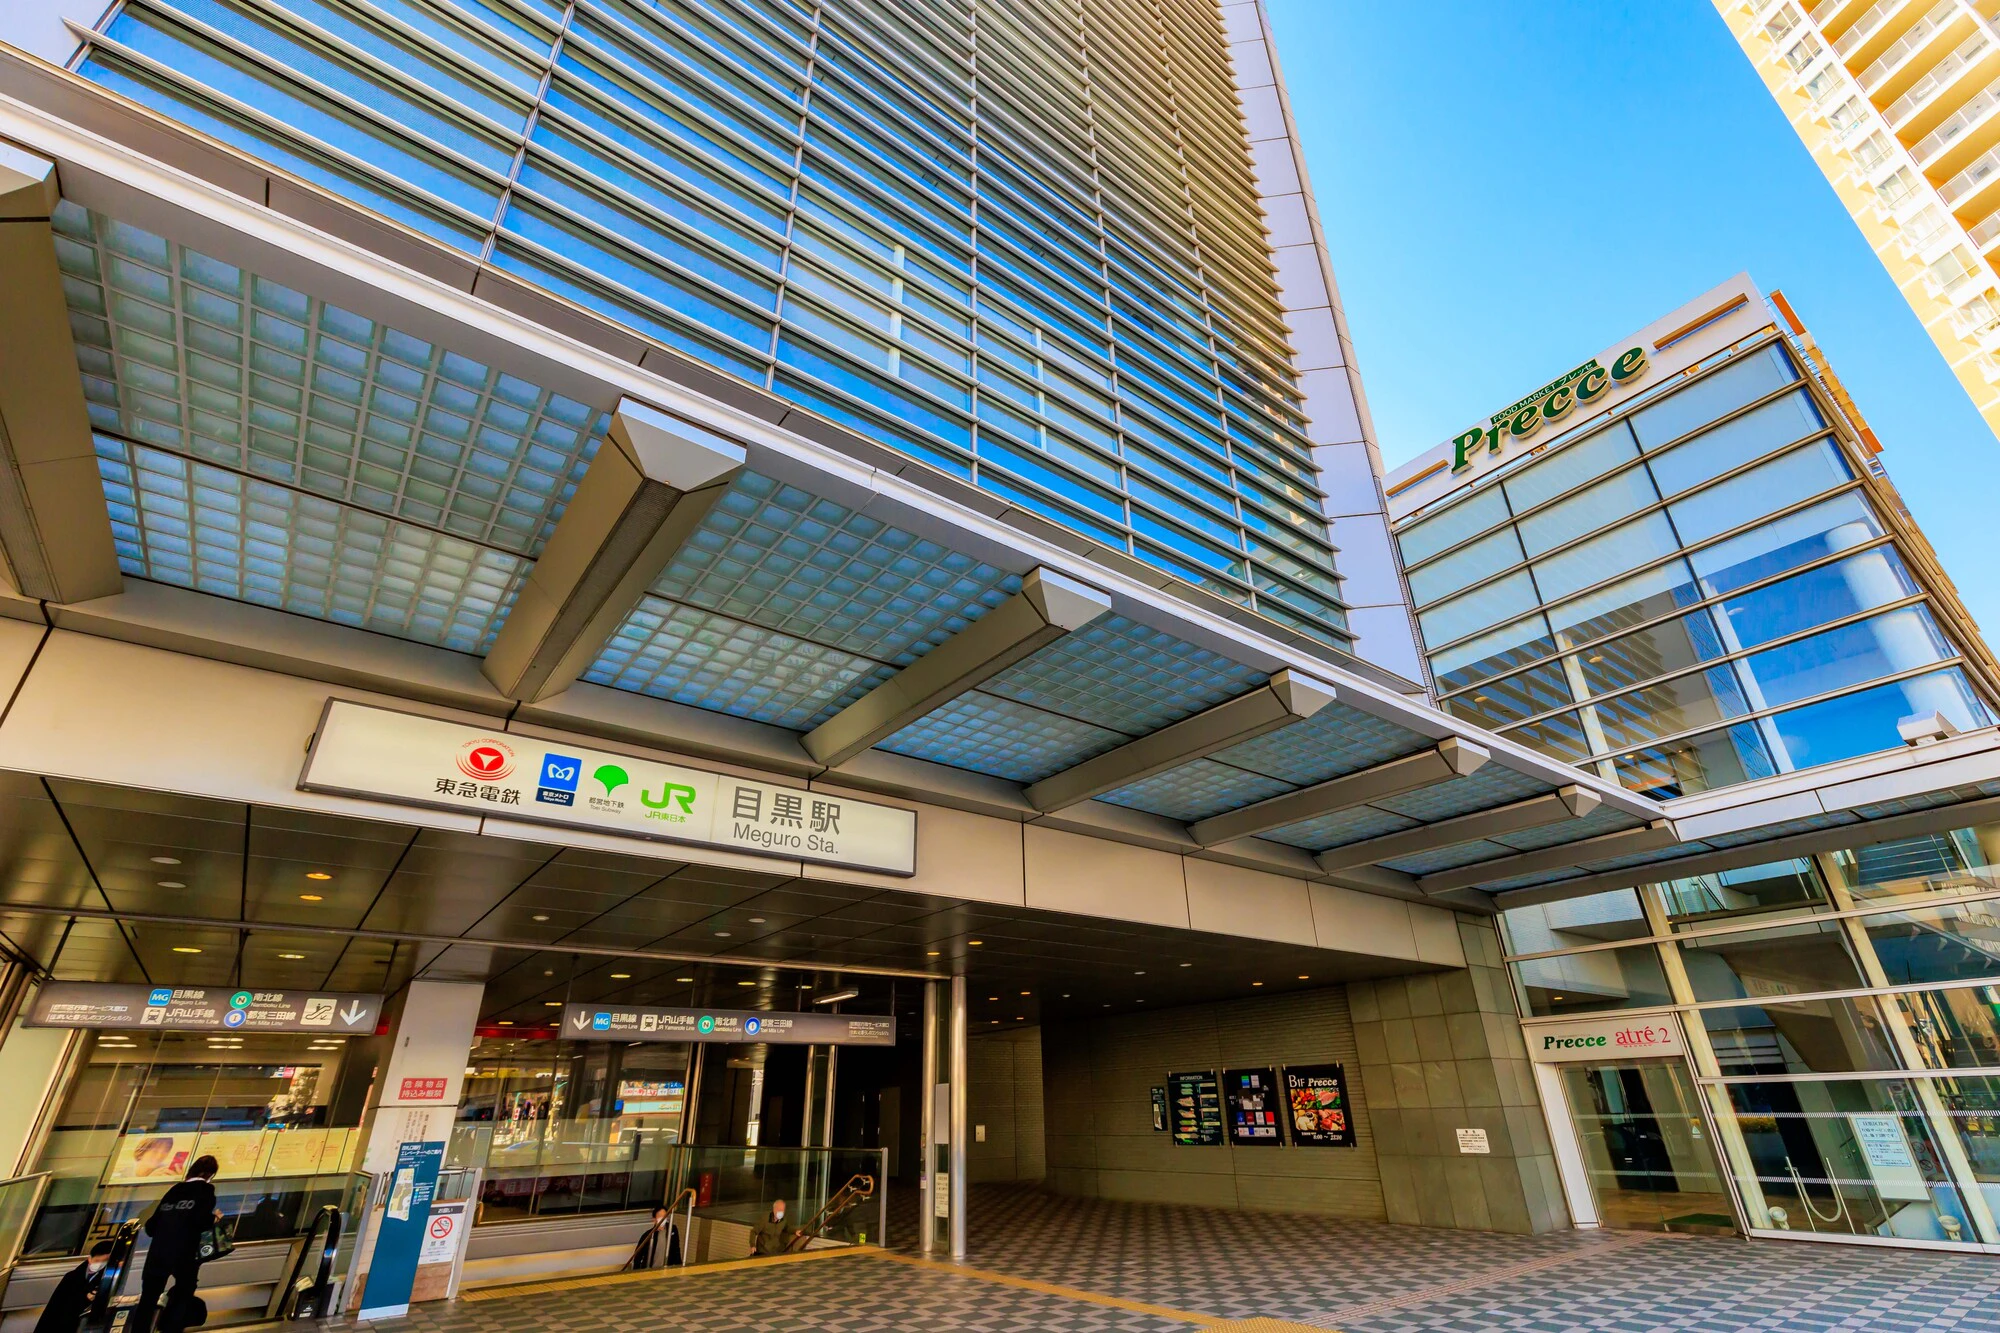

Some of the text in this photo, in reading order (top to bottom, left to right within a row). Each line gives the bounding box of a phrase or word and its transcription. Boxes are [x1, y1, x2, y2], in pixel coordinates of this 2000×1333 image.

[1493, 362, 1593, 422] FOOD MARKET プレッセ
[1451, 346, 1649, 474] Precce
[462, 738, 514, 758] TOKYU CORPORATION
[434, 777, 521, 805] 東急電鉄
[542, 790, 569, 800] 東京メトロ
[588, 796, 624, 809] 都営地下鉄
[641, 782, 697, 815] JR
[602, 806, 622, 814] Subway
[732, 785, 841, 835] 目黒駅
[645, 810, 687, 823] JR東日本
[733, 821, 839, 855] Meguro Sta.
[152, 990, 205, 1002] MG 目黒線
[253, 993, 283, 1002] 南北線
[166, 1008, 216, 1018] JR山手線
[247, 1011, 296, 1021] 都営三田線
[611, 1013, 637, 1023] 目黒線
[658, 1015, 695, 1025] JR山手線
[715, 1017, 738, 1027] 南北線
[761, 1019, 793, 1028] 都営三田線
[1543, 1026, 1671, 1050] Precce atré 2
[404, 1080, 444, 1088] 危険物品
[1288, 1074, 1338, 1088] B1F Precce
